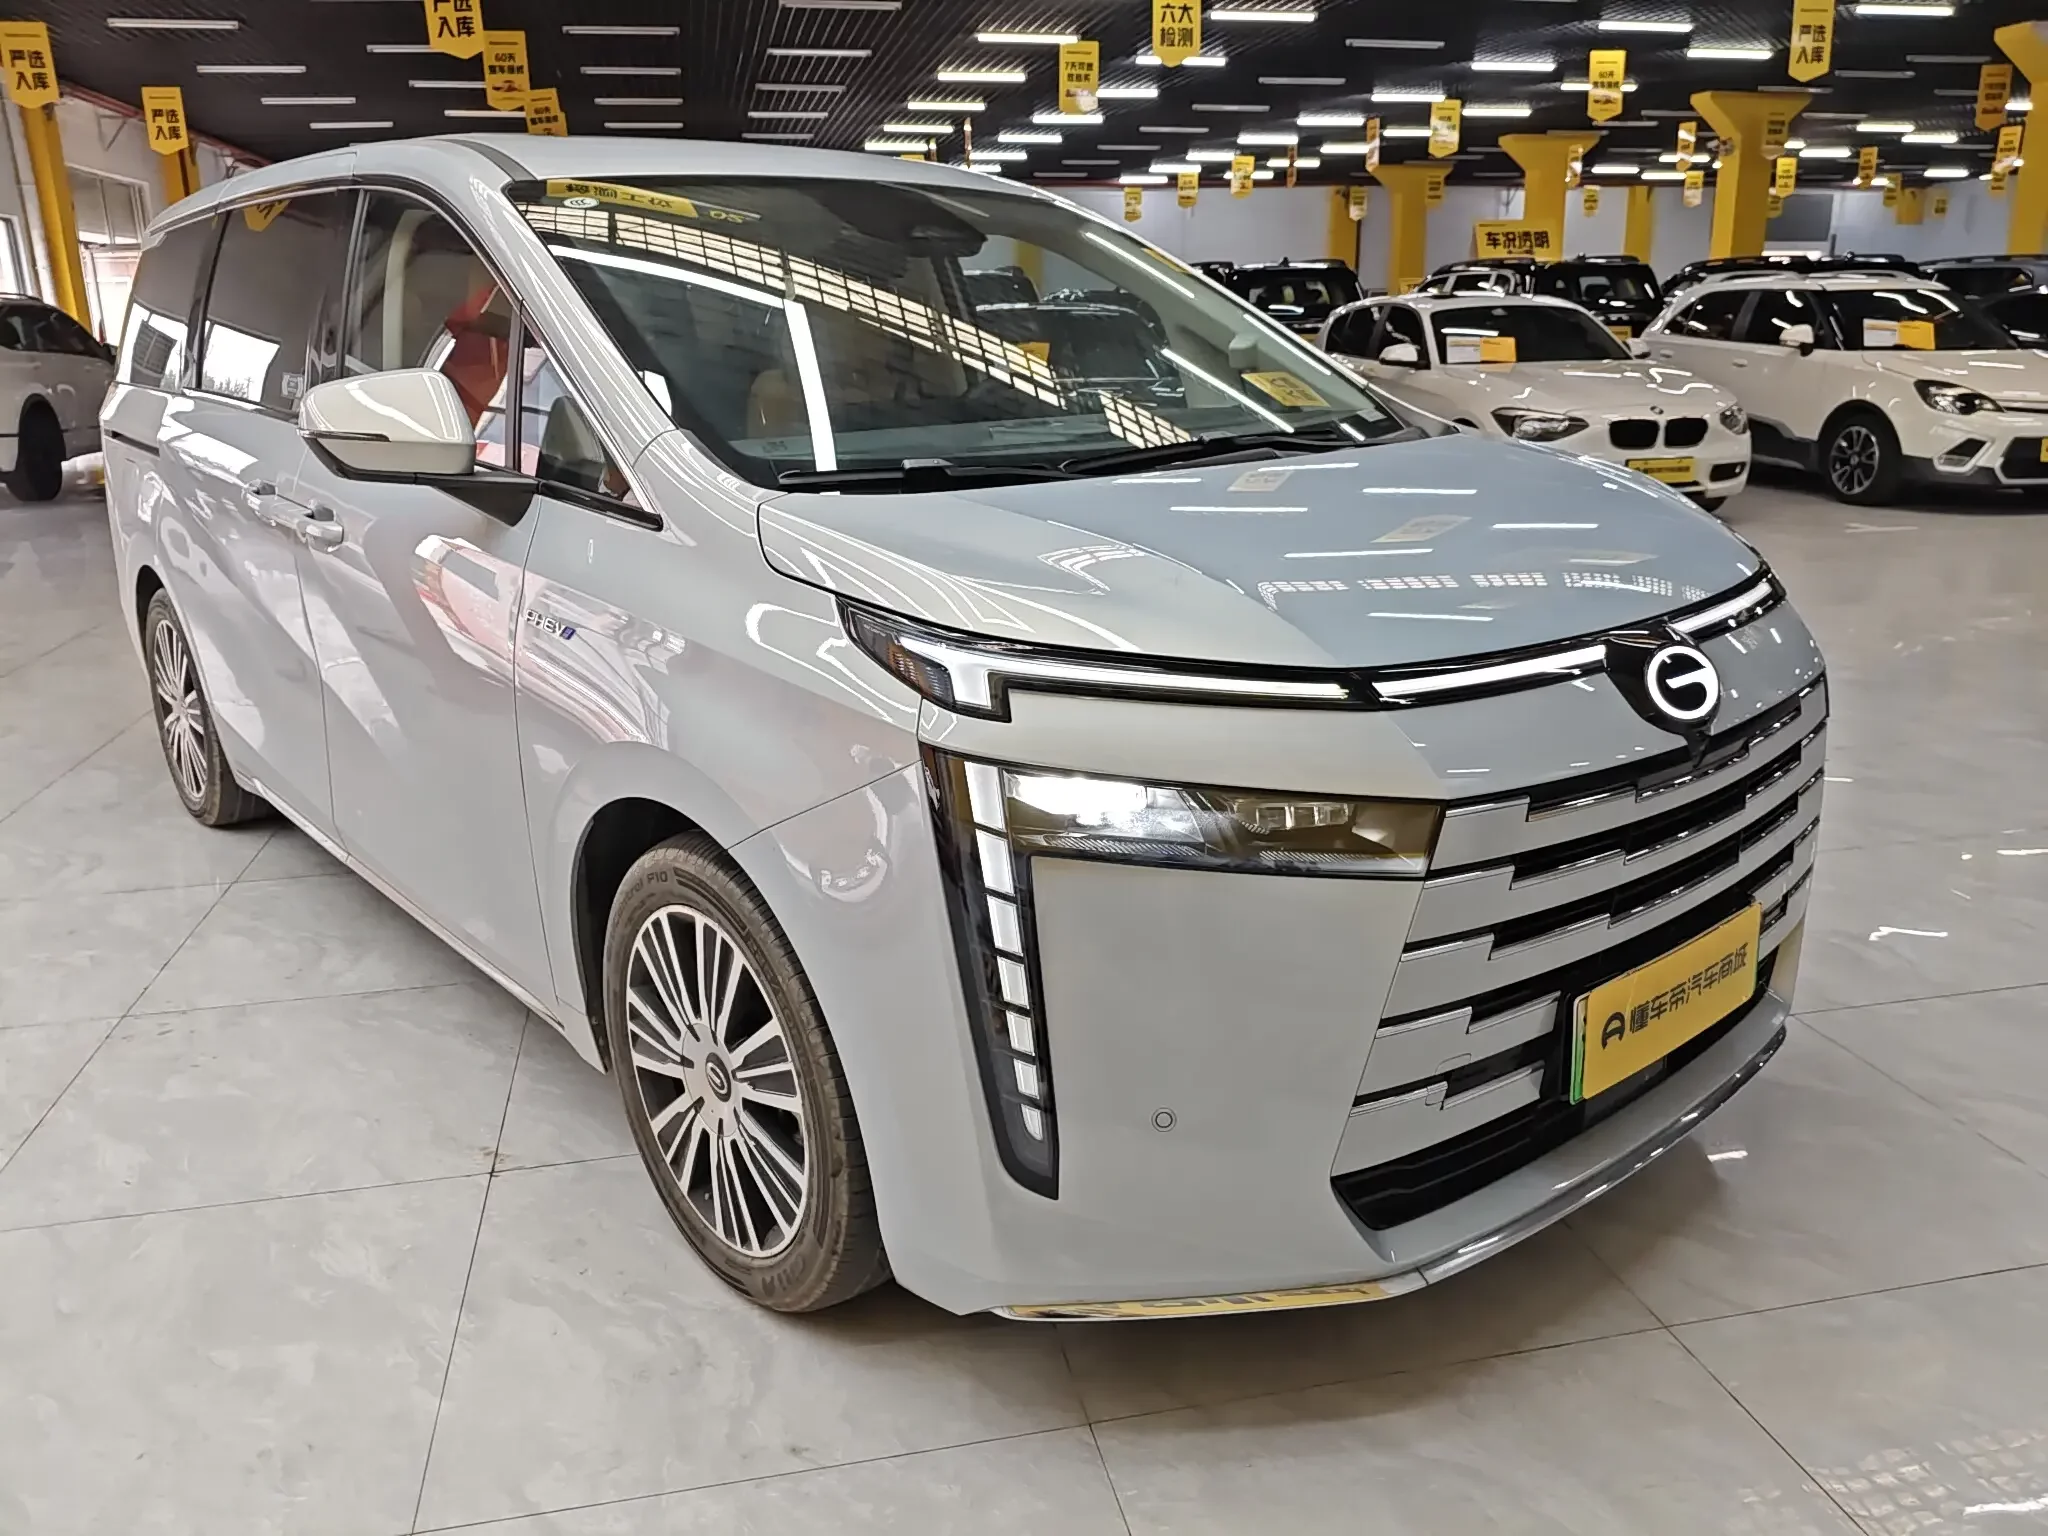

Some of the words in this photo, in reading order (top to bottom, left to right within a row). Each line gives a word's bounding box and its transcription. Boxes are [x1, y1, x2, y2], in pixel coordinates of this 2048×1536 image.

[1160, 3, 1193, 24] 六大
[437, 16, 475, 38] 入库
[1799, 24, 1826, 42] 严选
[1160, 27, 1193, 48] 检测
[9, 49, 46, 68] 严选
[1796, 46, 1825, 64] 入库
[16, 72, 50, 91] 入库
[151, 109, 179, 124] 严选
[155, 126, 182, 141] 入库
[1485, 231, 1550, 249] 车况透明
[1629, 942, 1749, 1034] 懂车帝汽车商城
